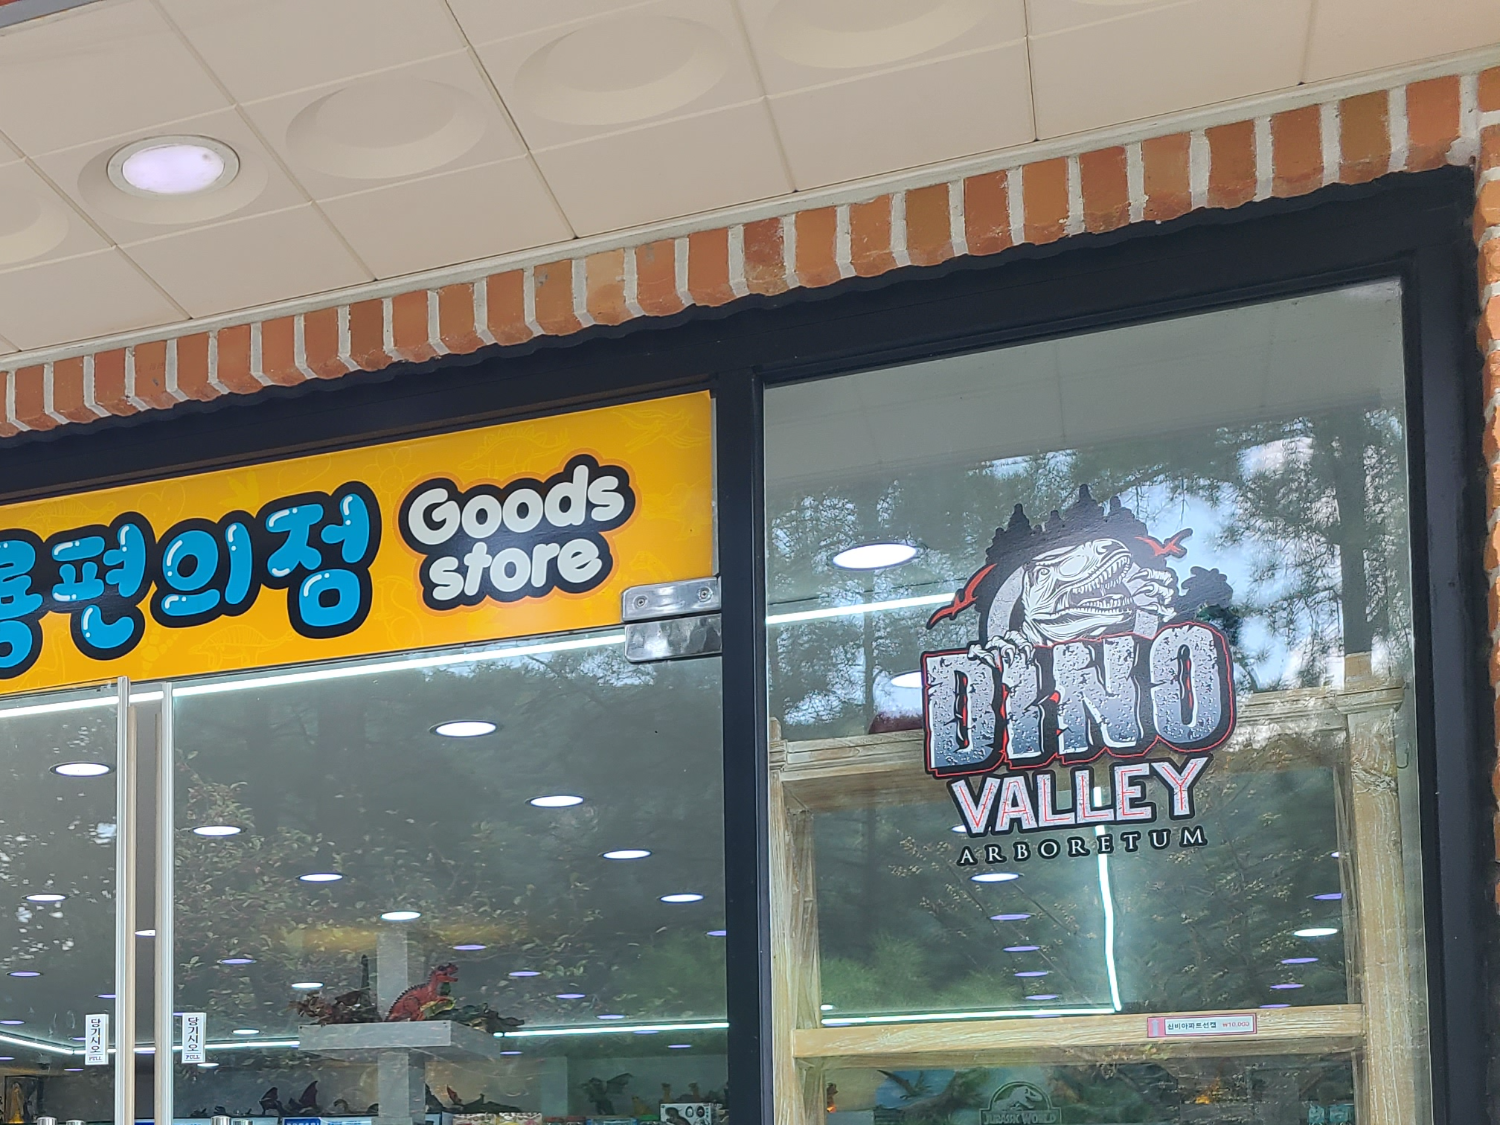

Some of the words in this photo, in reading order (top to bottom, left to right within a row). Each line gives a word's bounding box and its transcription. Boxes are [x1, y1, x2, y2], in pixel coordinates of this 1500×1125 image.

[404, 458, 630, 549] Goods
[428, 539, 606, 604] store
[921, 622, 1236, 777] DINO
[949, 755, 1213, 837] VALLEY
[957, 826, 1208, 866] ARBORETUM
[90, 1018, 101, 1053] 당기시오
[187, 1017, 199, 1052] 당기시오
